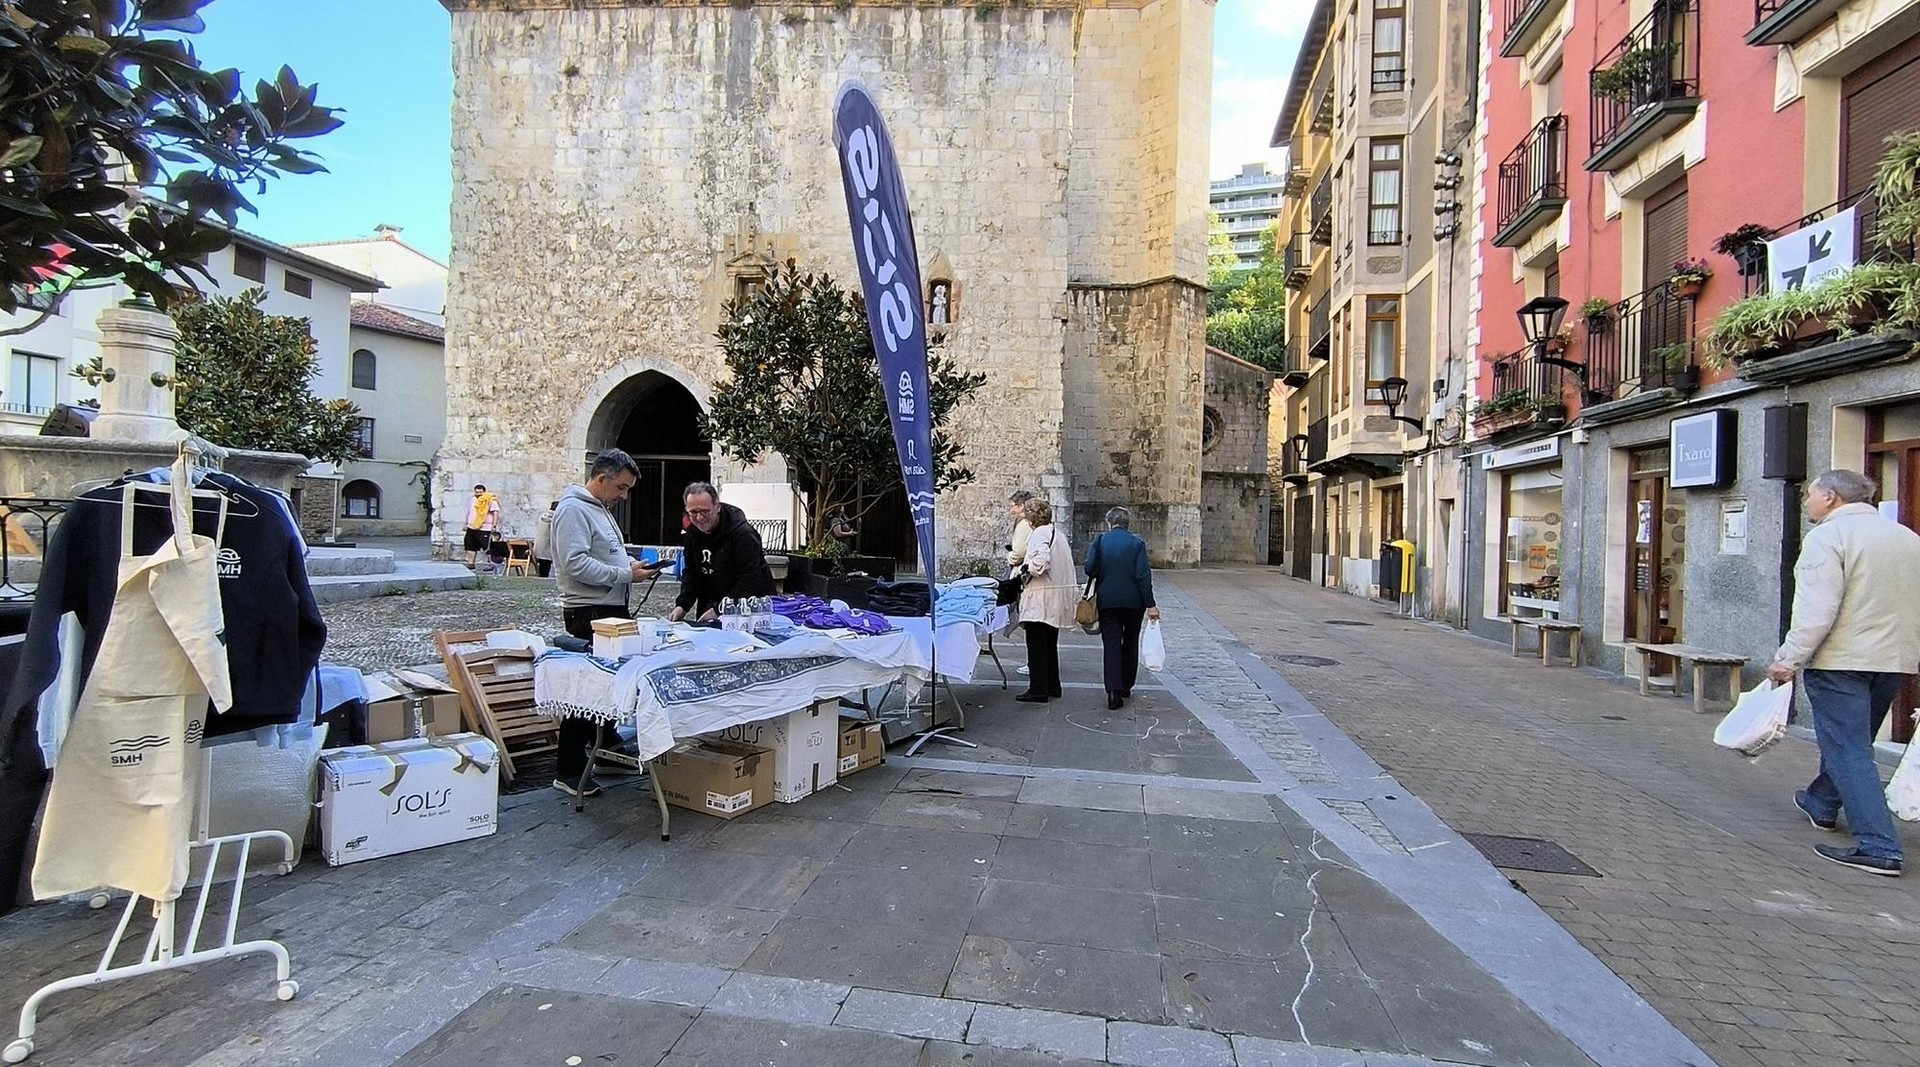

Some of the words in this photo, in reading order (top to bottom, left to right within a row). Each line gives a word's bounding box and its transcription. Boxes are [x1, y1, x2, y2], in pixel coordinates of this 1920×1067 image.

[1677, 443, 1712, 462] Txaro
[217, 564, 242, 575] MH
[111, 753, 143, 765] SMH
[391, 787, 452, 816] SOL'S
